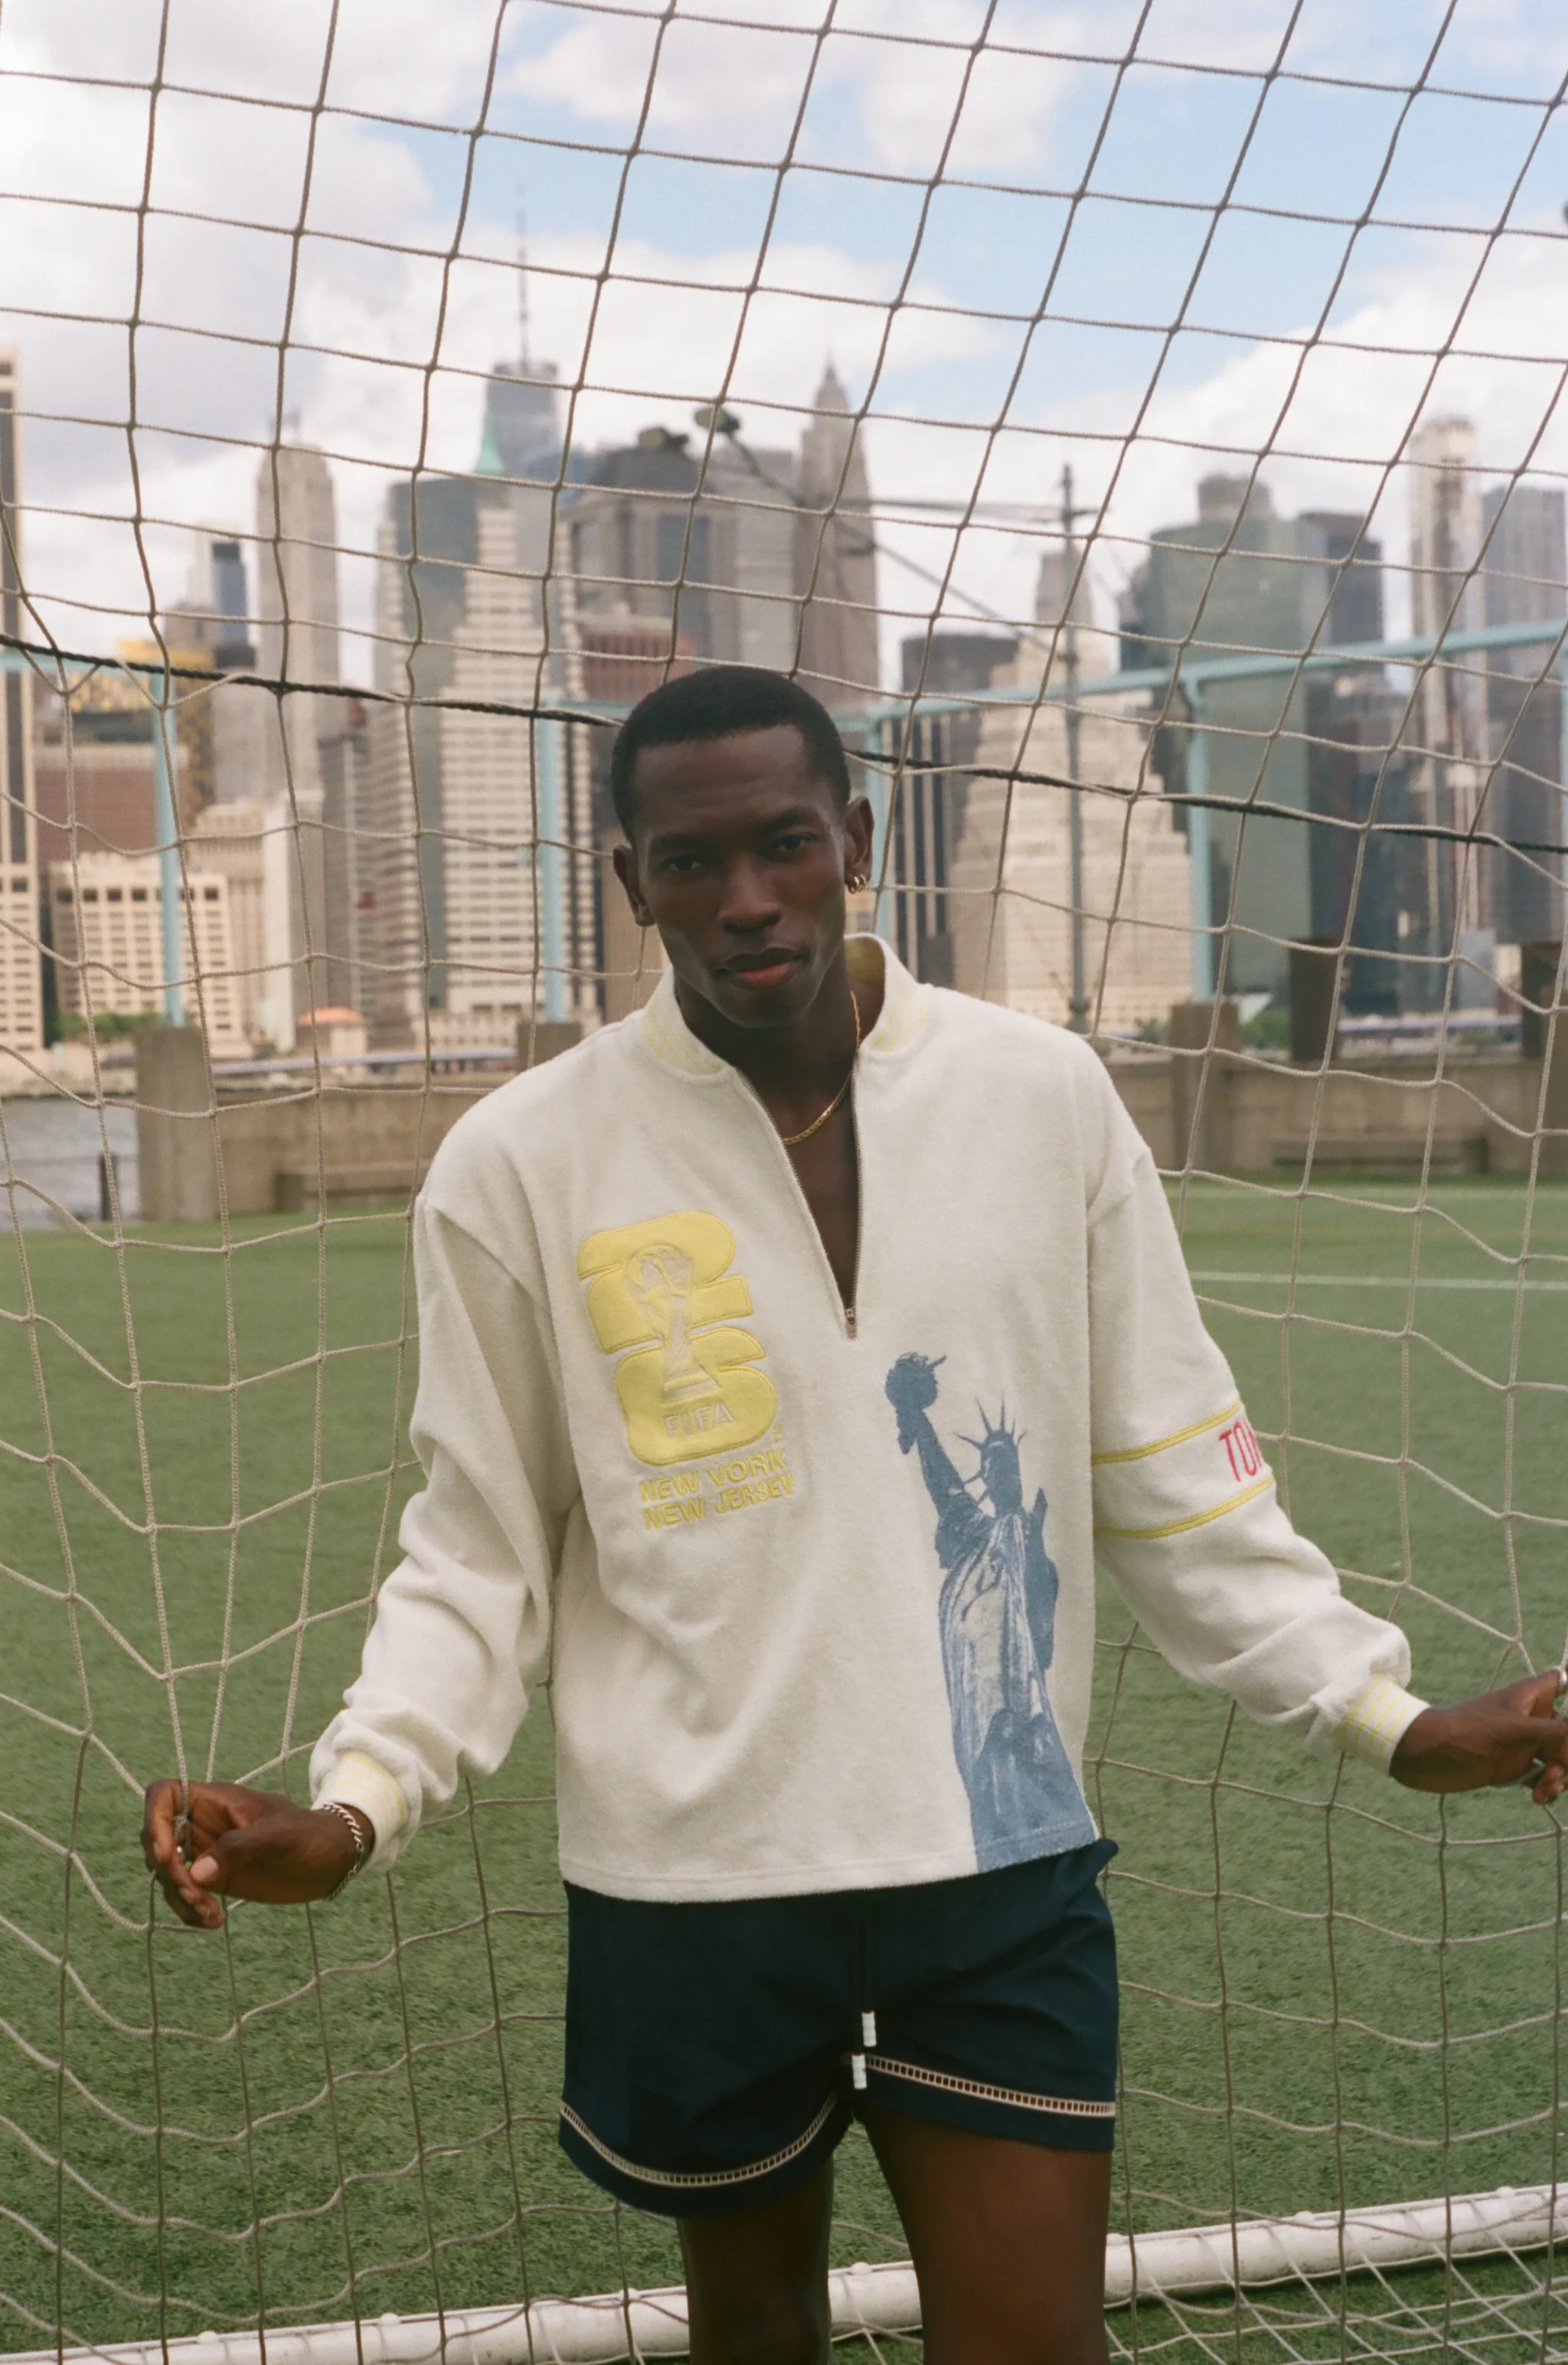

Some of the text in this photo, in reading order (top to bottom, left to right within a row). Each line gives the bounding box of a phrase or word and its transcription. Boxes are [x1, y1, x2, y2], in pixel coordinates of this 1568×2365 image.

[664, 1402, 734, 1439] FIFA
[639, 1447, 787, 1503] NEW YORK
[643, 1474, 794, 1530] NEW JERSEY
